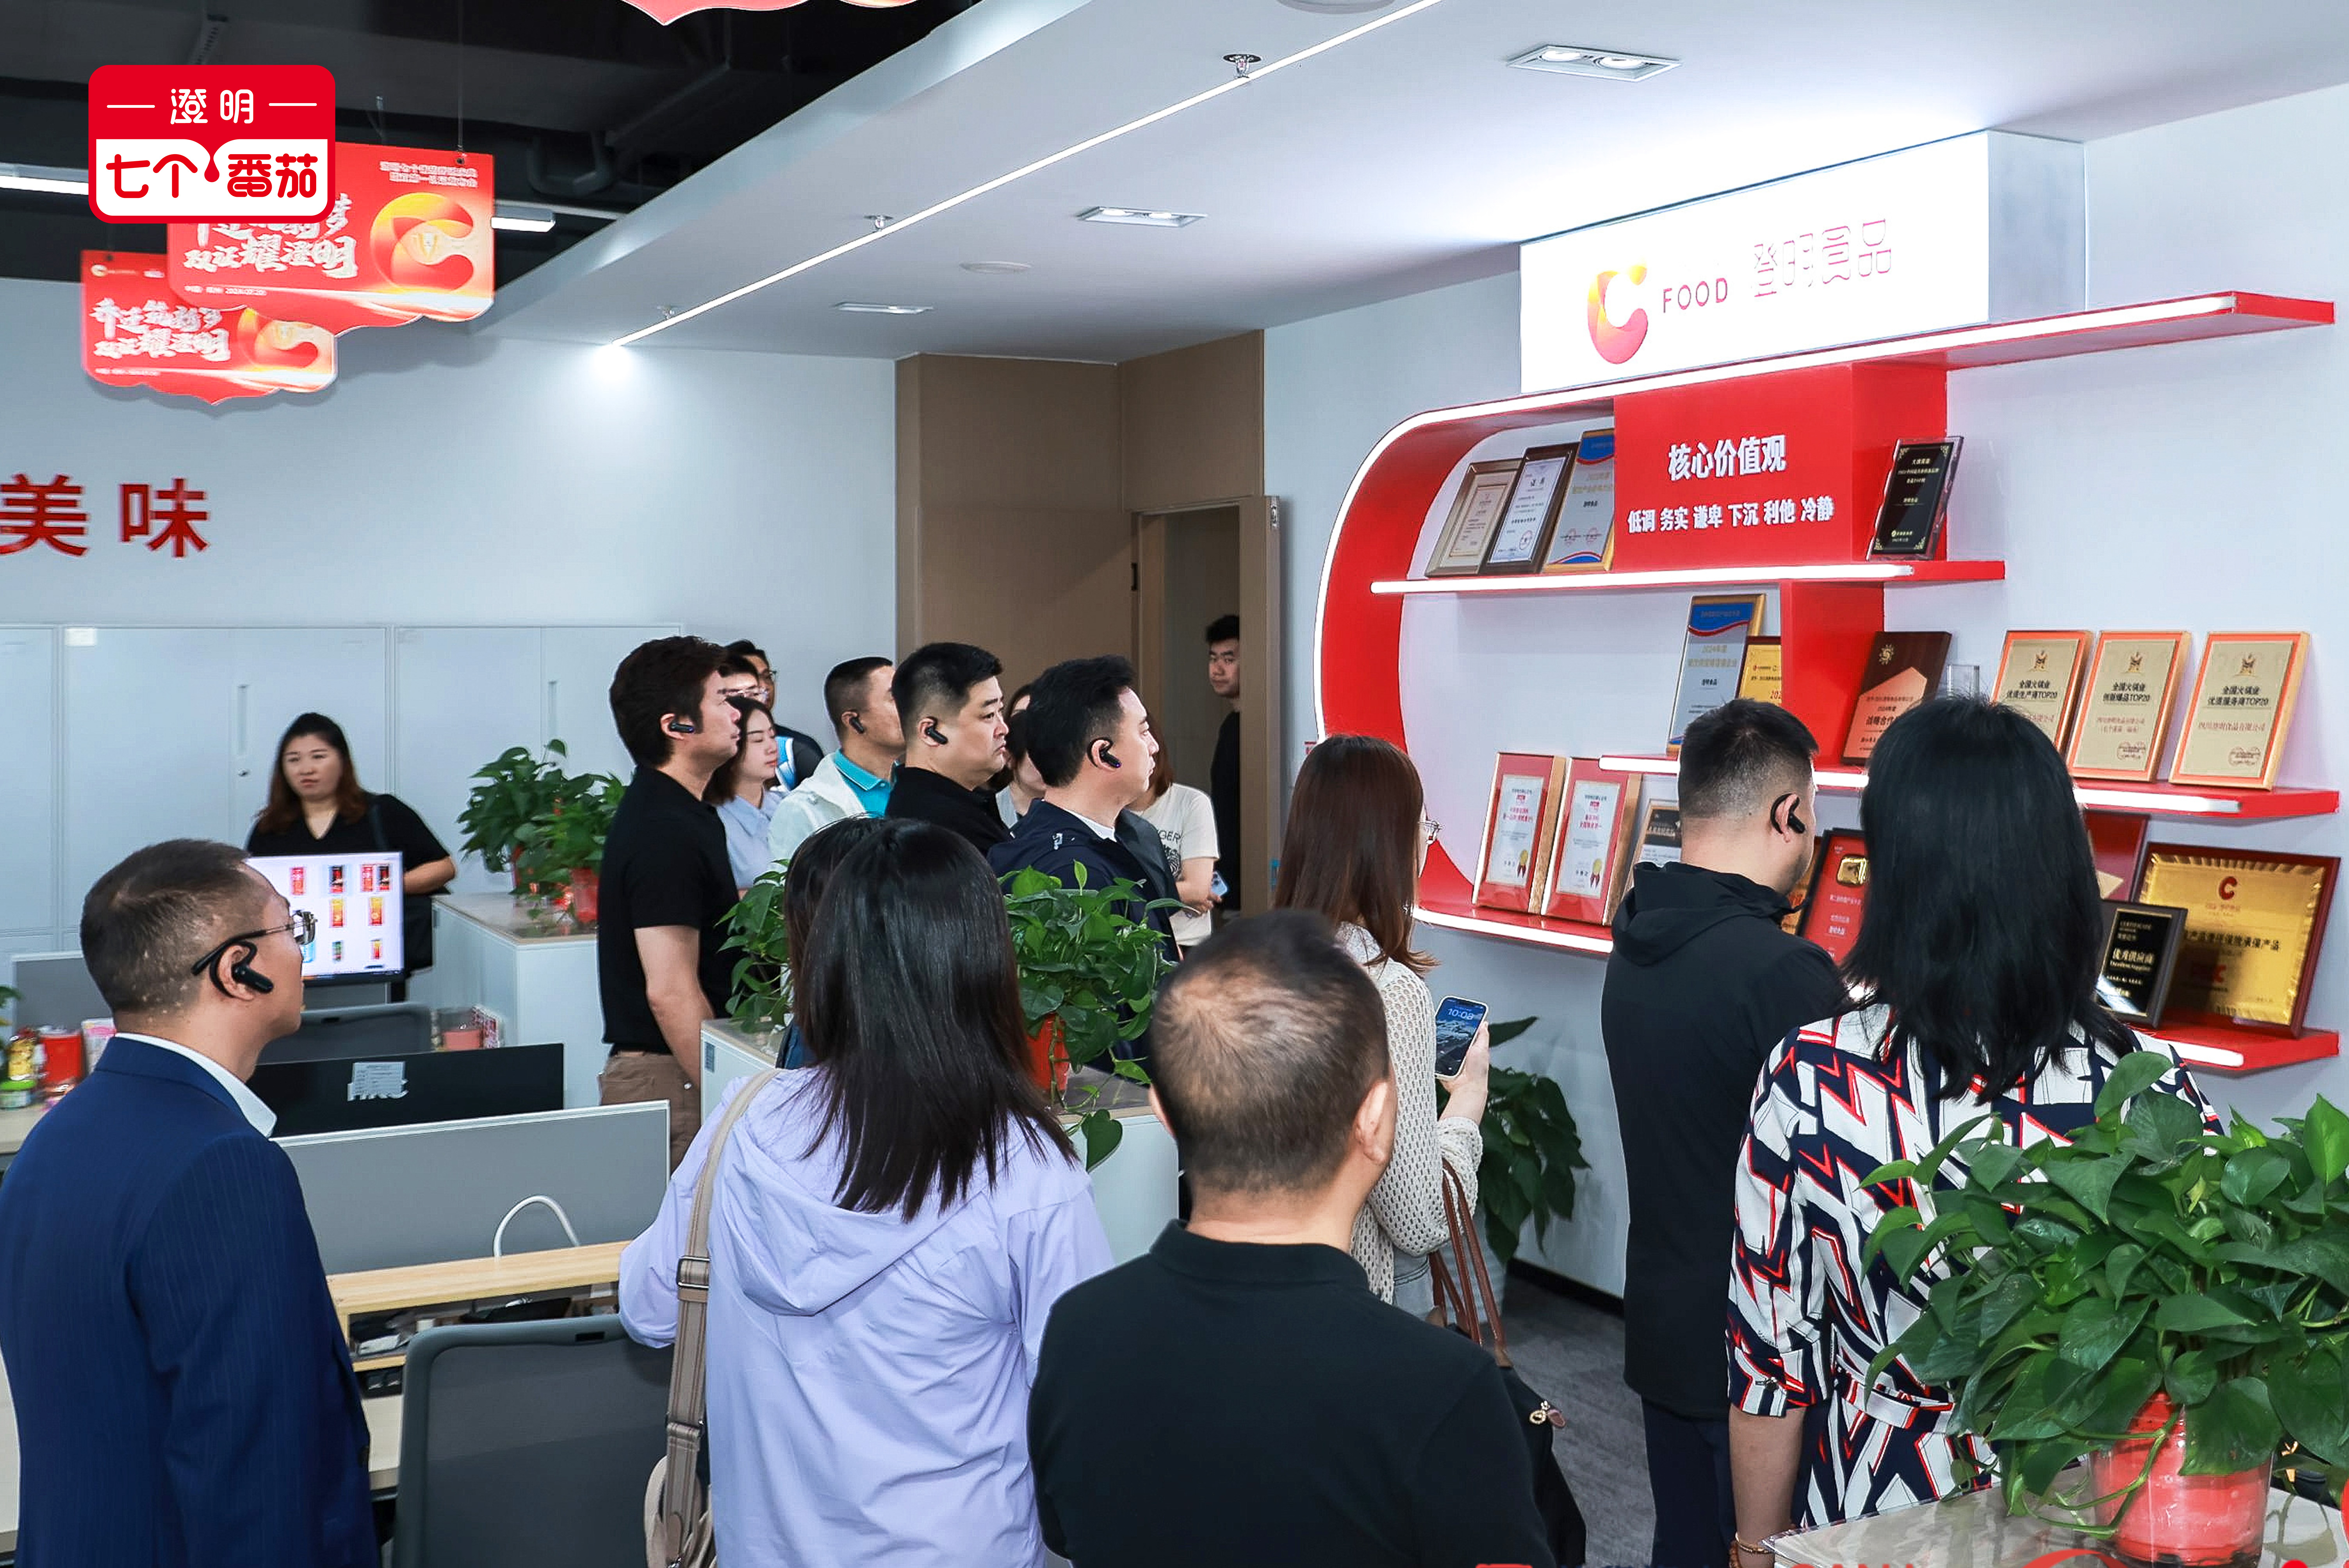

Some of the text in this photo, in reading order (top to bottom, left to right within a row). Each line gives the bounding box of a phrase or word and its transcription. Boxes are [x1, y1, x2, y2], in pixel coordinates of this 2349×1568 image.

[1663, 277, 1728, 313] FOOD
[1668, 435, 1786, 481] 核心价值观
[0, 474, 210, 558] 美味
[1627, 495, 1835, 533] 低调 务实 谦卑 下沉 利他 冷静
